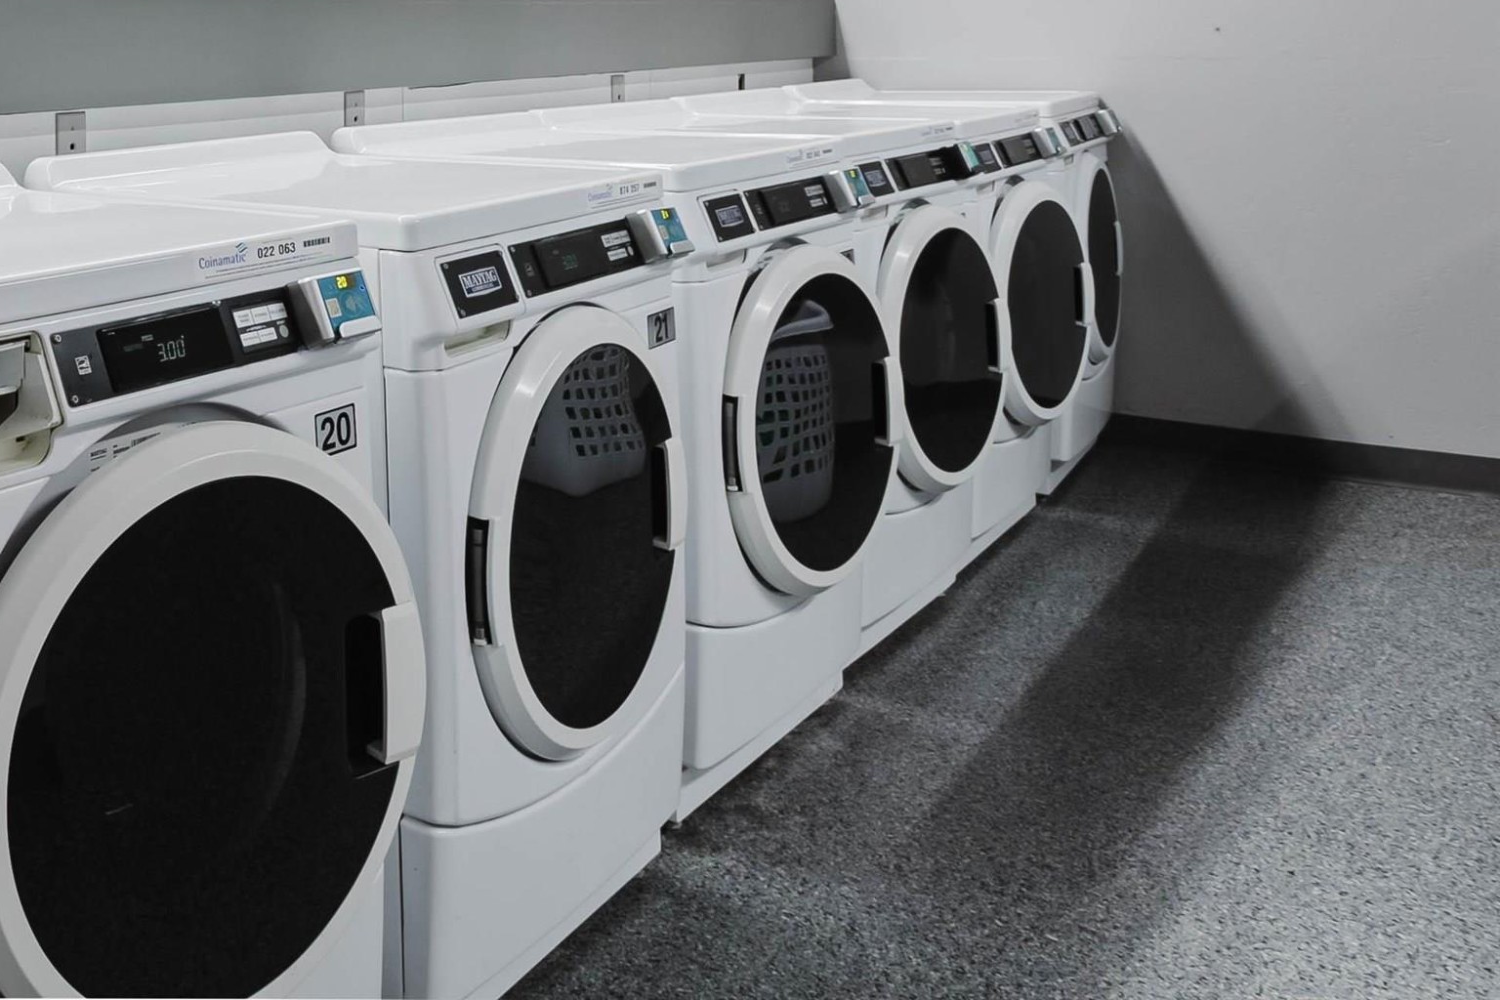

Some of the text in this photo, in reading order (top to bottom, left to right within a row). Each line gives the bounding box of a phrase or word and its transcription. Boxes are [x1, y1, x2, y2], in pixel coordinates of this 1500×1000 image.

[198, 252, 246, 270] Coinamatic
[257, 245, 275, 259] 022
[278, 241, 296, 255] 063
[462, 269, 497, 289] MAYTAG
[654, 312, 669, 344] 21
[321, 411, 351, 452] 20
